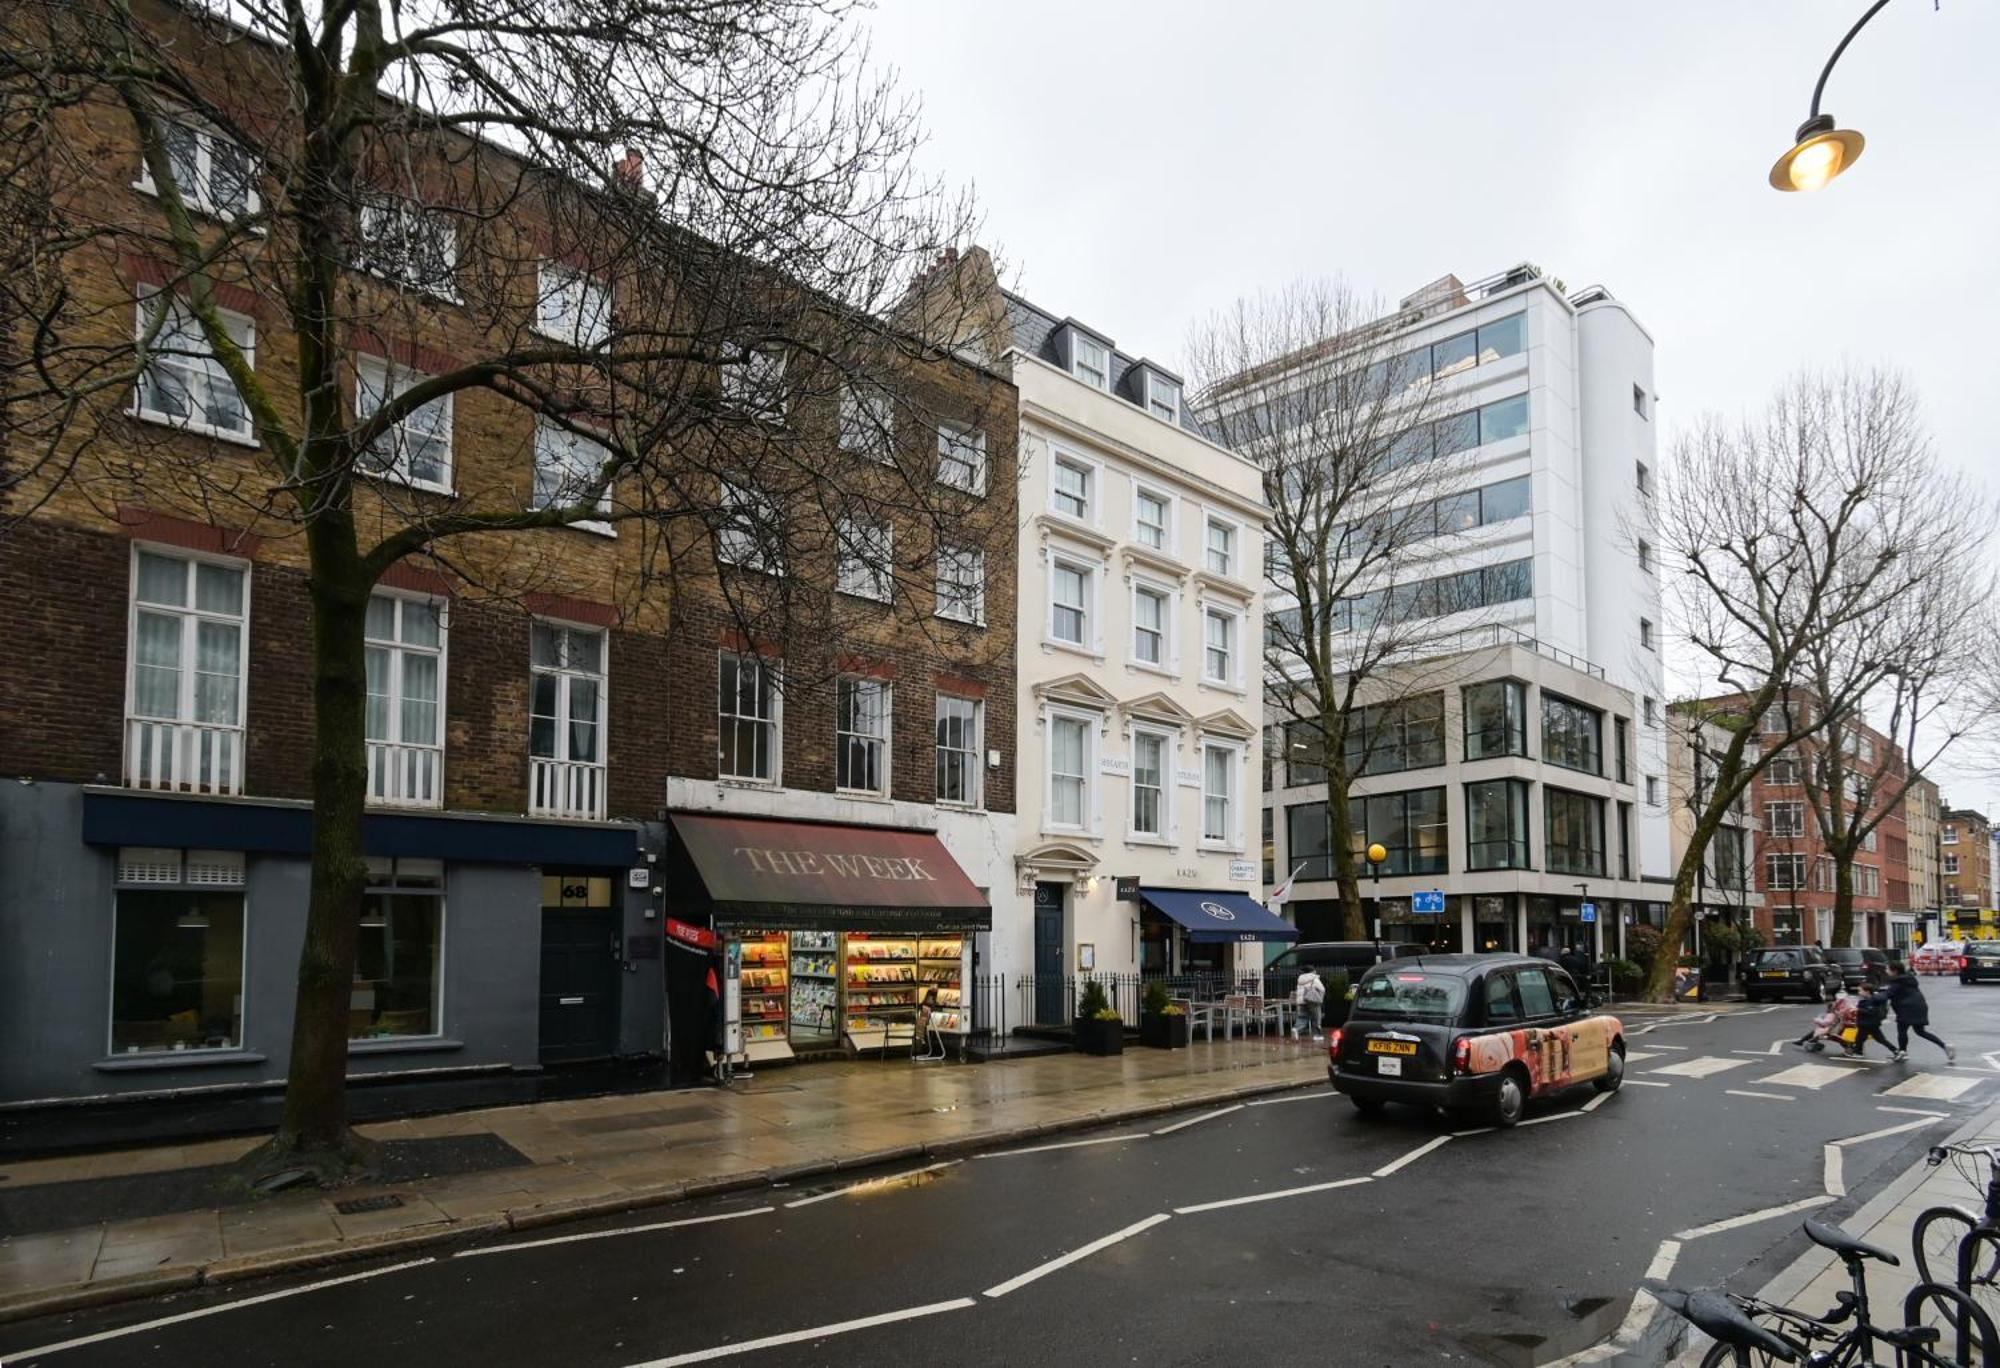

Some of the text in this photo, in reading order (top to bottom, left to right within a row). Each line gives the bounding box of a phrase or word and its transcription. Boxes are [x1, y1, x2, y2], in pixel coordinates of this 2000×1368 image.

[734, 848, 938, 881] THE WEEK
[563, 885, 588, 898] 68
[1239, 934, 1256, 942] KAZU
